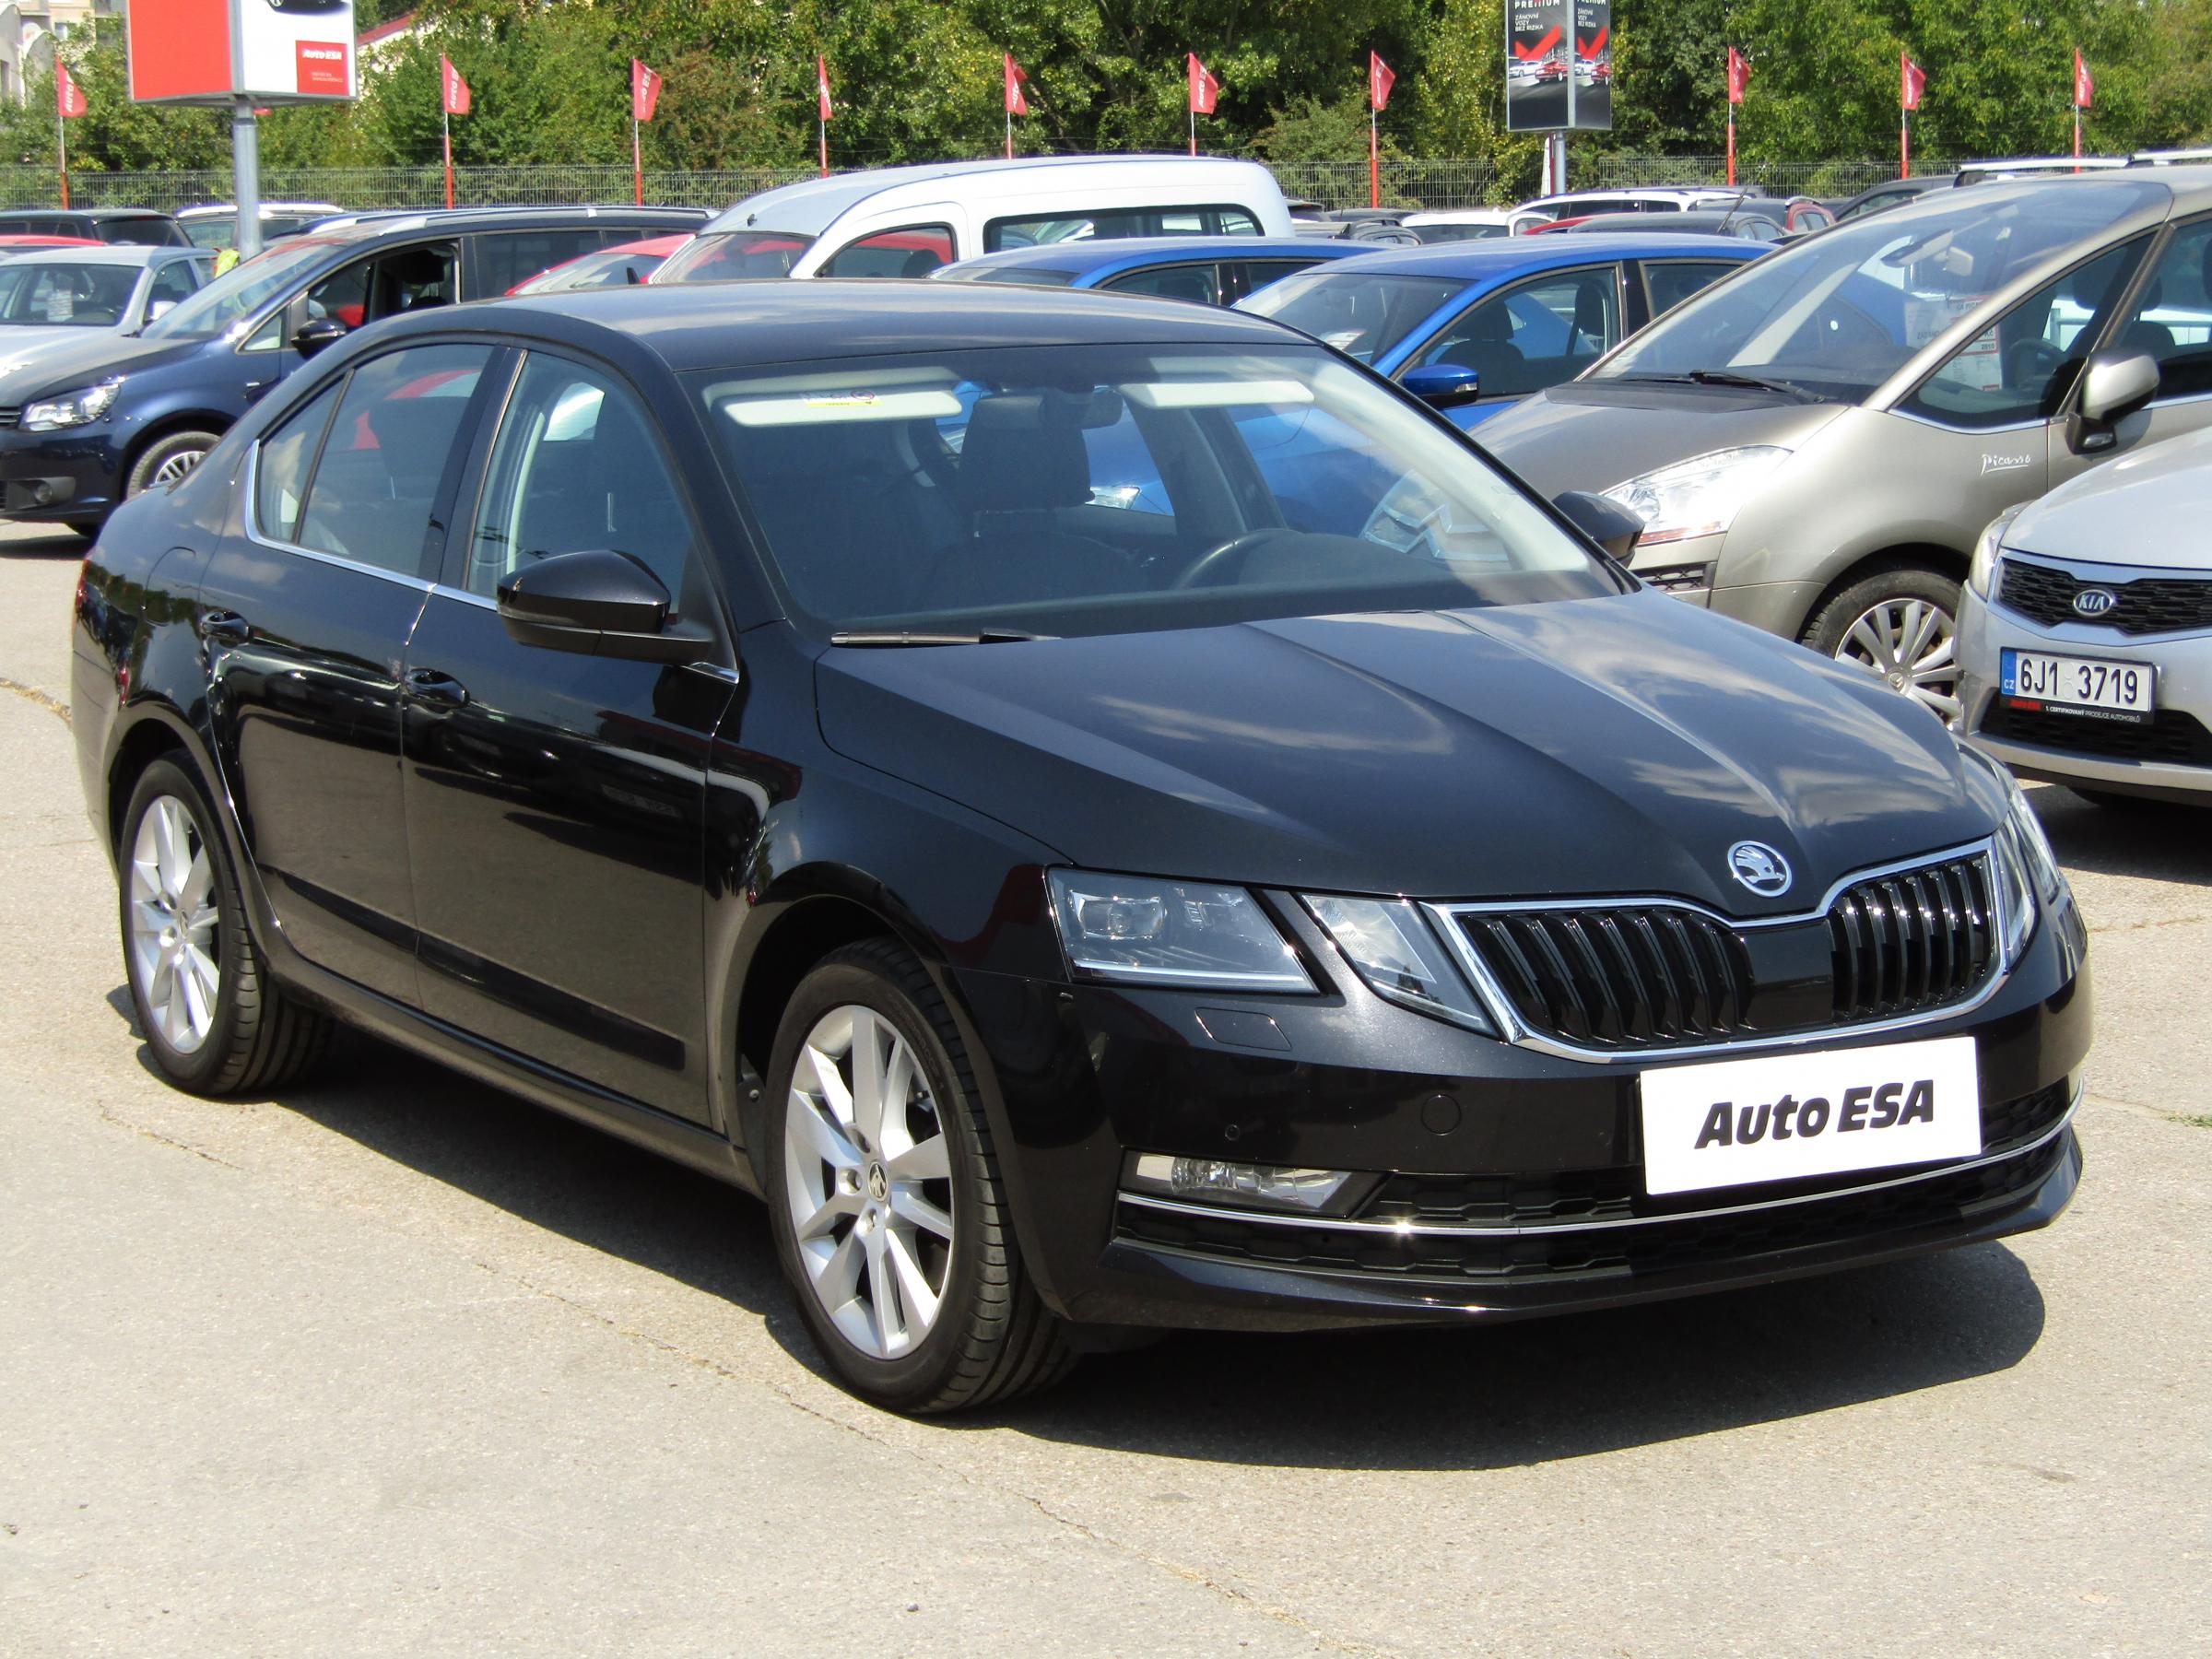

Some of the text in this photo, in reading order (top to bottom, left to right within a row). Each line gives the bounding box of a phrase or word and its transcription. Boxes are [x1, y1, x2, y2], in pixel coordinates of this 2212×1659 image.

[1980, 453, 2031, 477] Picasso
[2078, 594, 2105, 611] KIA
[2004, 678, 2015, 690] CZ
[2020, 658, 2138, 704] 6J1 3719
[1694, 1079, 1934, 1149] Auto ESA
